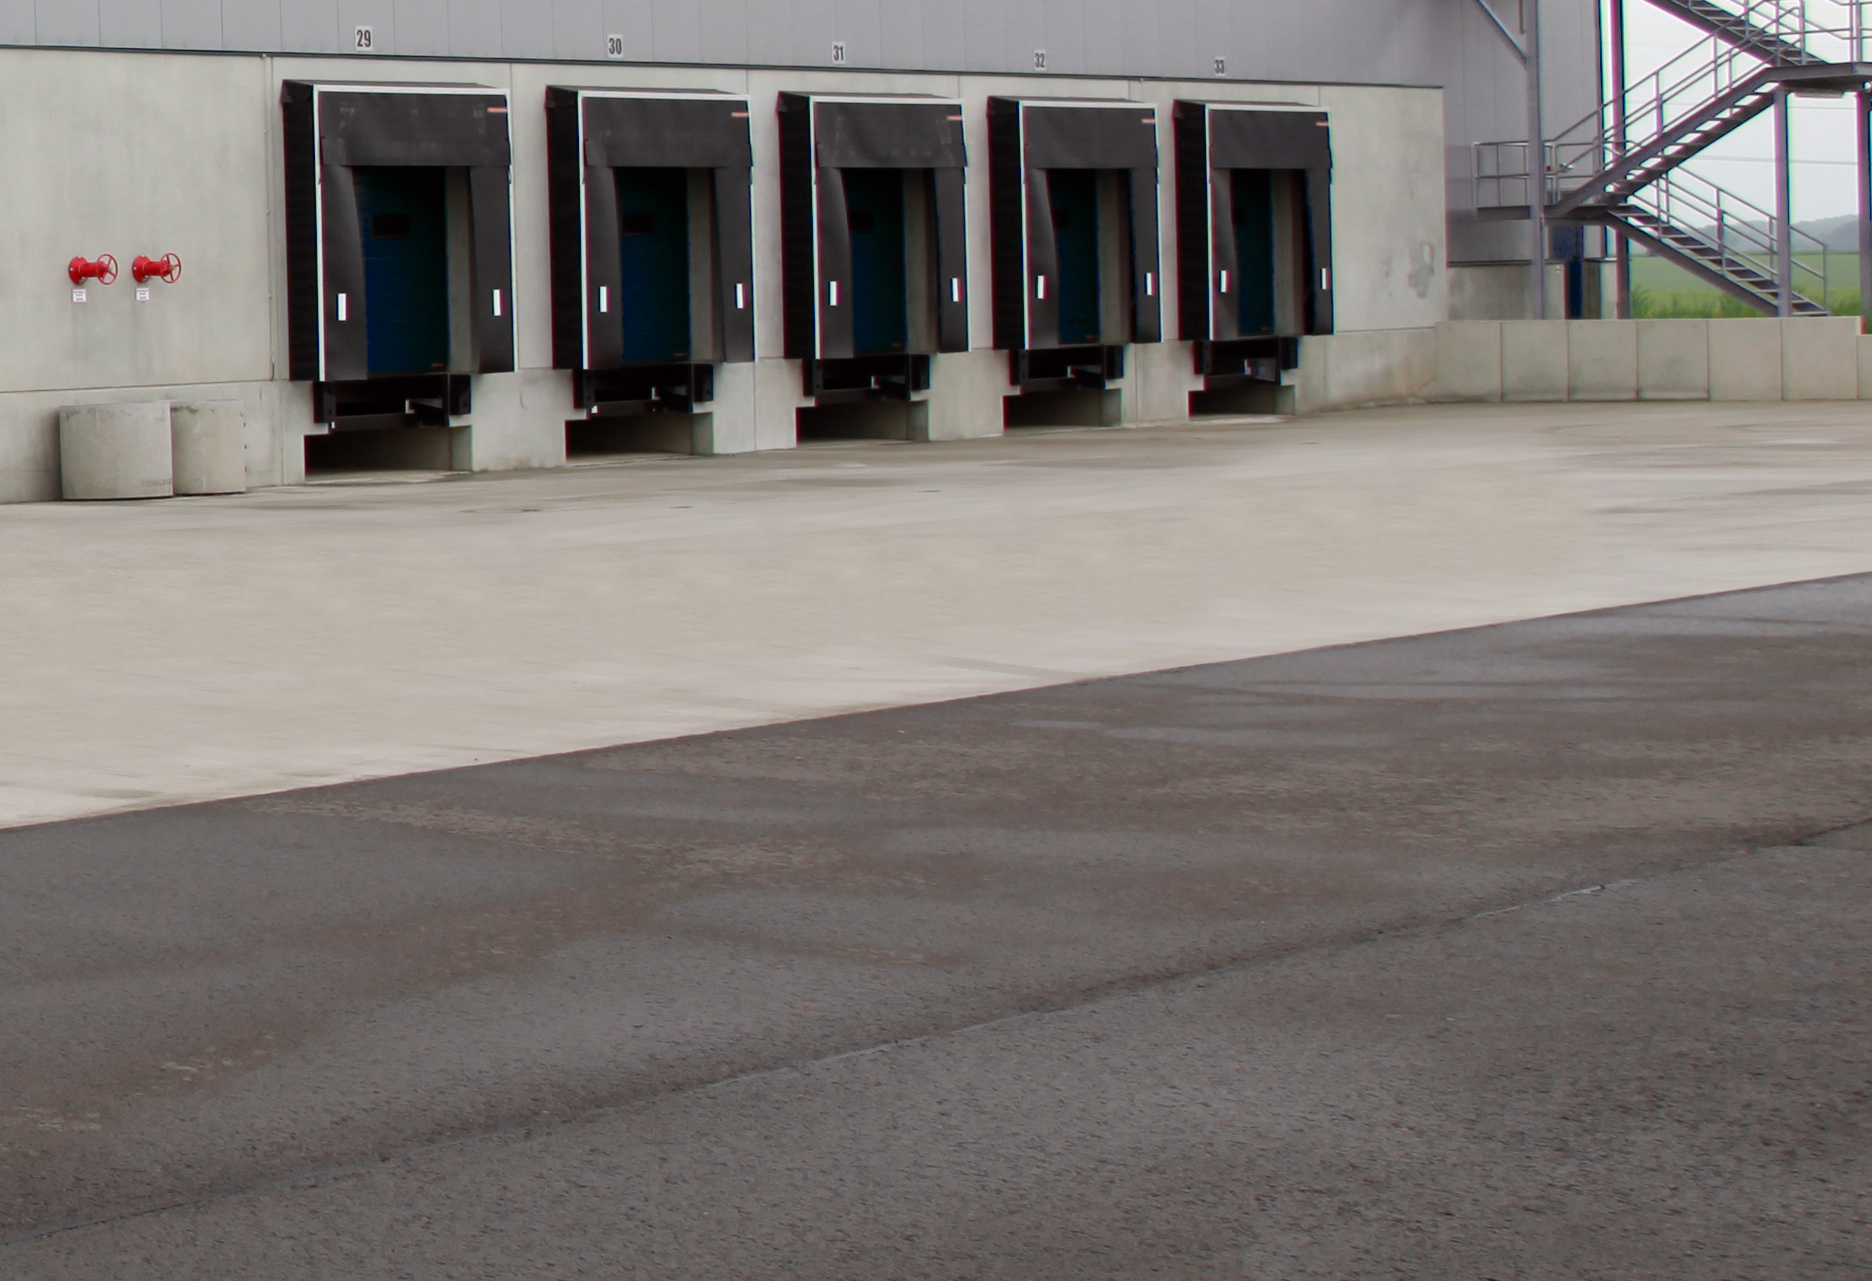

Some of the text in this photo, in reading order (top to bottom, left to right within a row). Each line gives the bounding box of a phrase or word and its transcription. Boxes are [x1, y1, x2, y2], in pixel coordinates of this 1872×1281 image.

[356, 29, 371, 47] 29
[608, 38, 622, 54] 30
[833, 45, 844, 61] 31
[1034, 52, 1045, 68] 32
